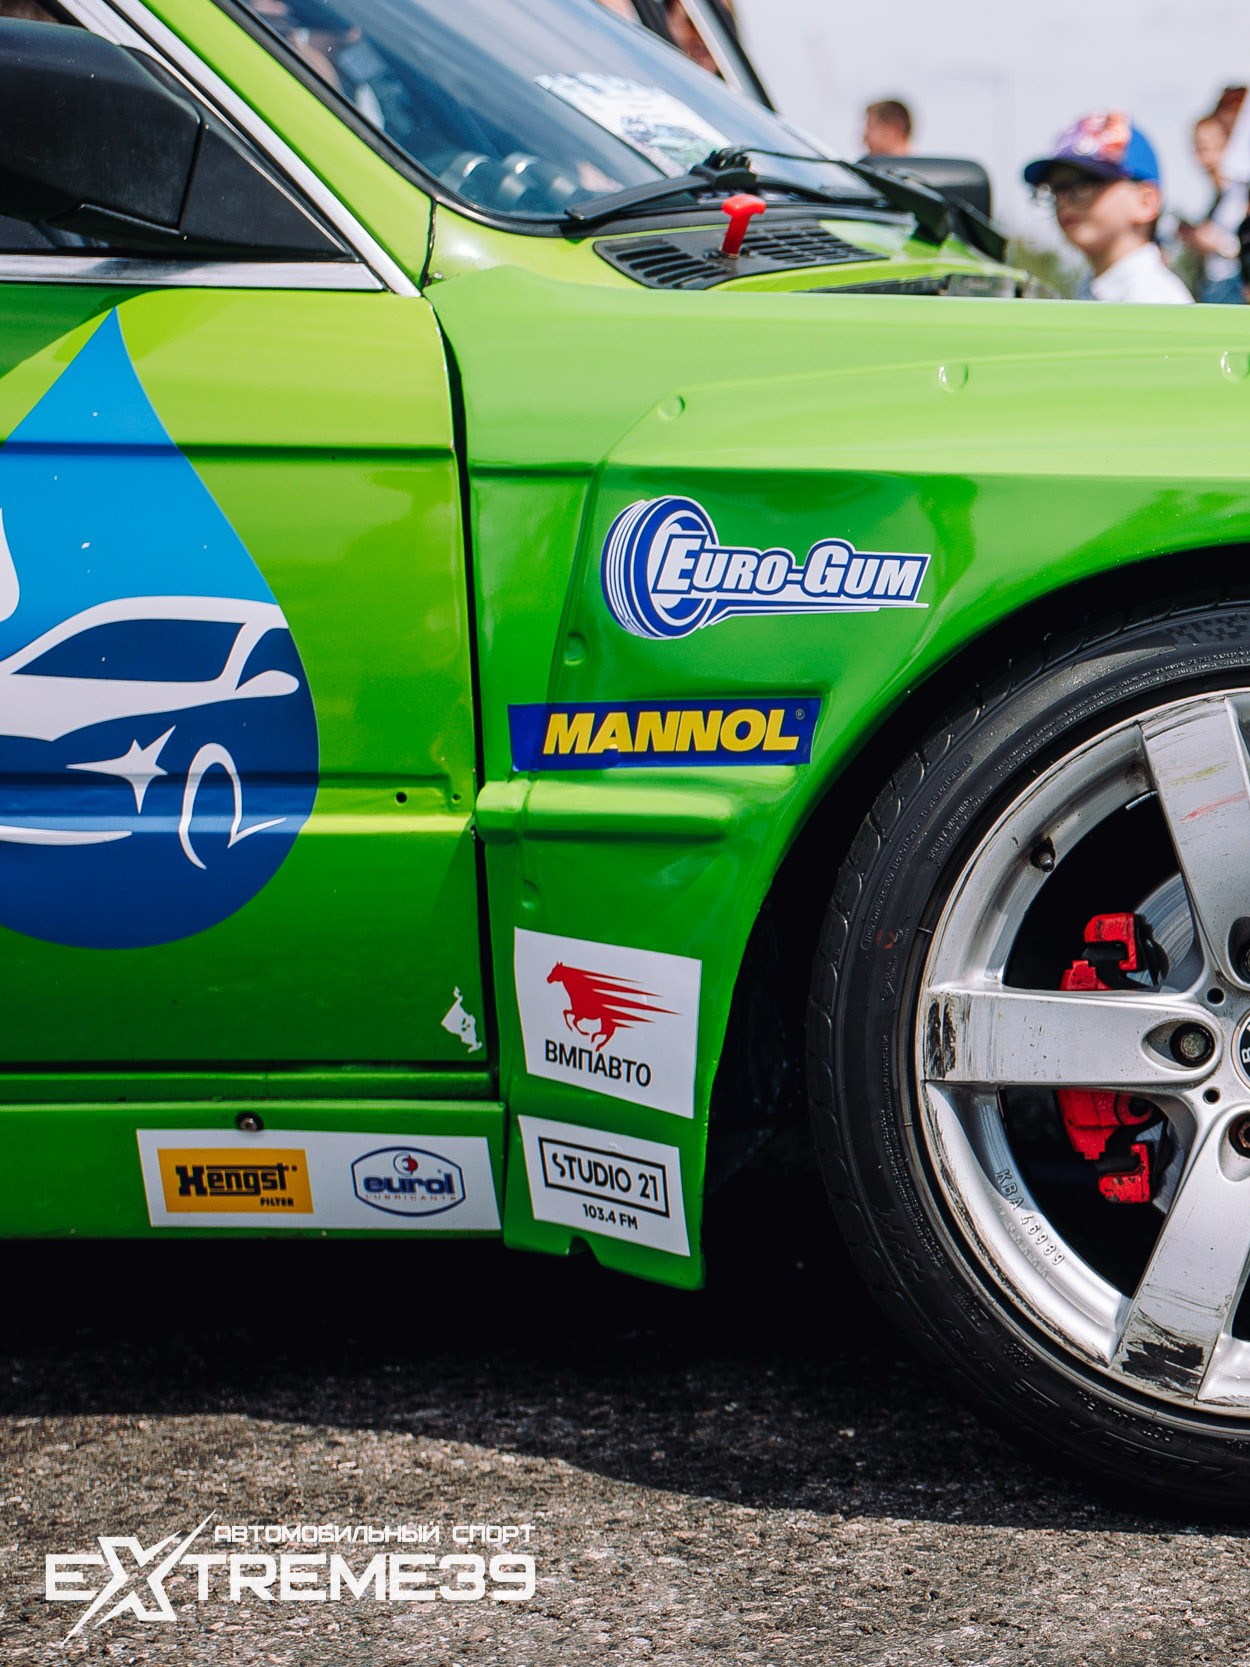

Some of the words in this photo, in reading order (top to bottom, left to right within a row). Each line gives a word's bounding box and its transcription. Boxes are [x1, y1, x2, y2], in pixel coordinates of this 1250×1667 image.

[655, 536, 924, 597] EURO-GUM
[542, 708, 800, 755] MANNOL
[544, 1038, 653, 1089] ВМПАВТО
[177, 1162, 290, 1197] Hengst
[363, 1172, 456, 1195] eurol
[551, 1152, 632, 1194] STUDIO
[637, 1172, 659, 1202] 21
[260, 1197, 294, 1208] FILTER
[582, 1203, 617, 1225] 103.4
[619, 1212, 638, 1230] FM
[995, 1168, 1025, 1211] KBA
[1020, 1214, 1066, 1266] 46989
